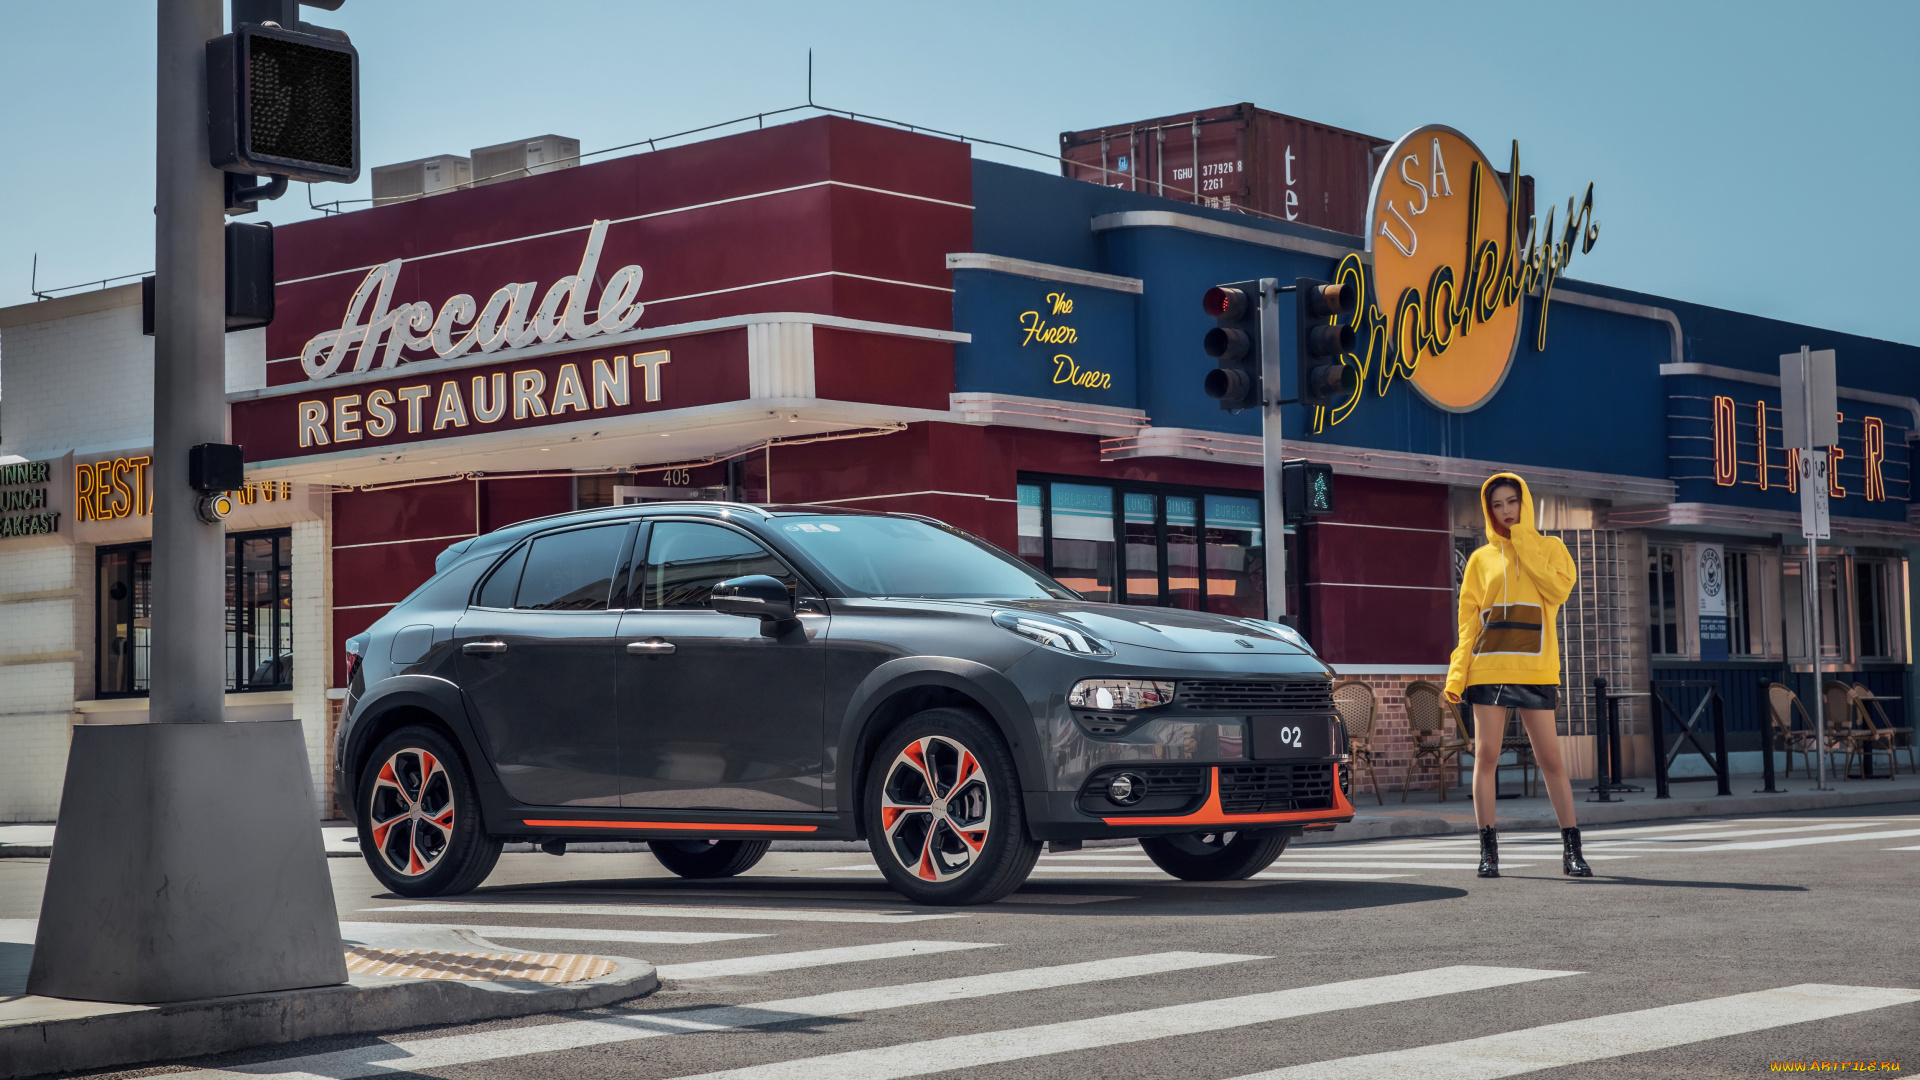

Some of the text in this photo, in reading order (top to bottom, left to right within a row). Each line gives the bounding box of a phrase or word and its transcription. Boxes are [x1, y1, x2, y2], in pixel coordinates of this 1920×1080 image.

[1173, 160, 1243, 180] TGHU 377926 8
[1203, 178, 1224, 191] 22G1
[1377, 138, 1453, 257] USA
[301, 219, 644, 380] Arcade
[1046, 292, 1074, 316] The
[299, 350, 672, 448] RESTAURANT
[1713, 395, 1886, 502] DIER
[663, 469, 690, 486] 405
[1058, 491, 1109, 509] BREAKFAST
[1215, 504, 1251, 519] BURGERS
[1280, 726, 1302, 748] 02
